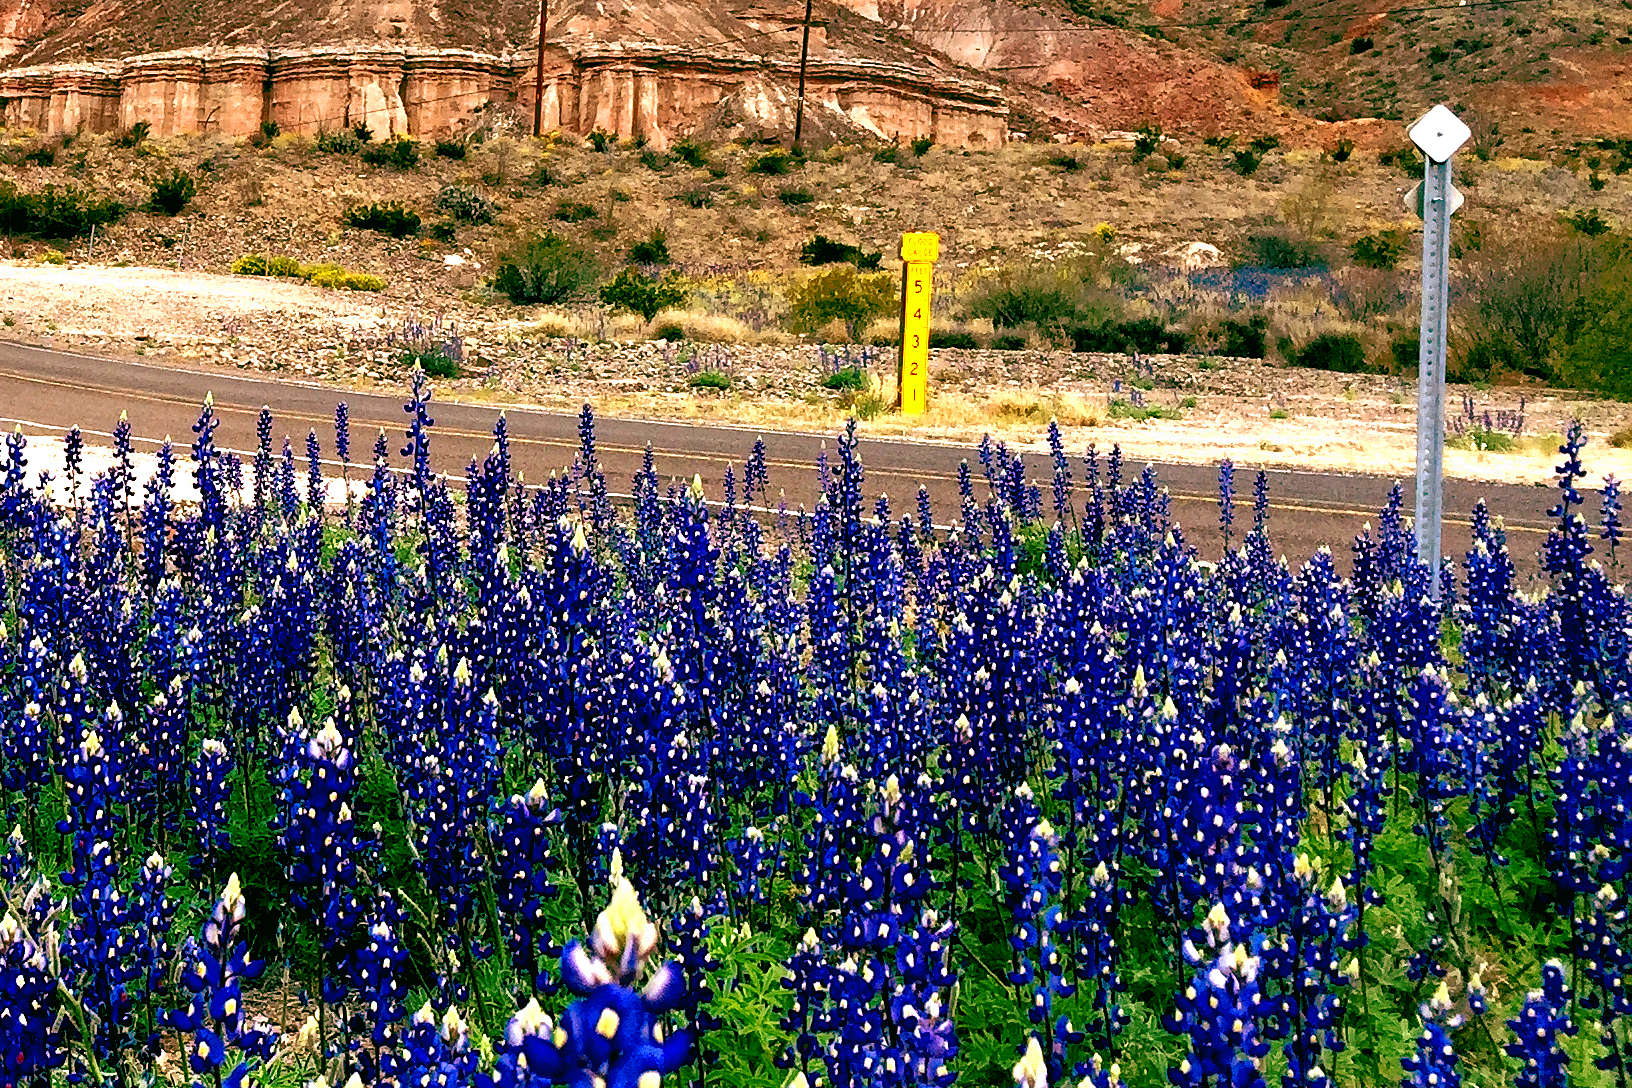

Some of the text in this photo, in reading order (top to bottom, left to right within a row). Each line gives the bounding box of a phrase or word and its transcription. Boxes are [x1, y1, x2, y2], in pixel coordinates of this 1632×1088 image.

[914, 280, 923, 293] 5
[913, 308, 922, 320] 4
[912, 334, 920, 348] 3
[910, 362, 918, 376] 2
